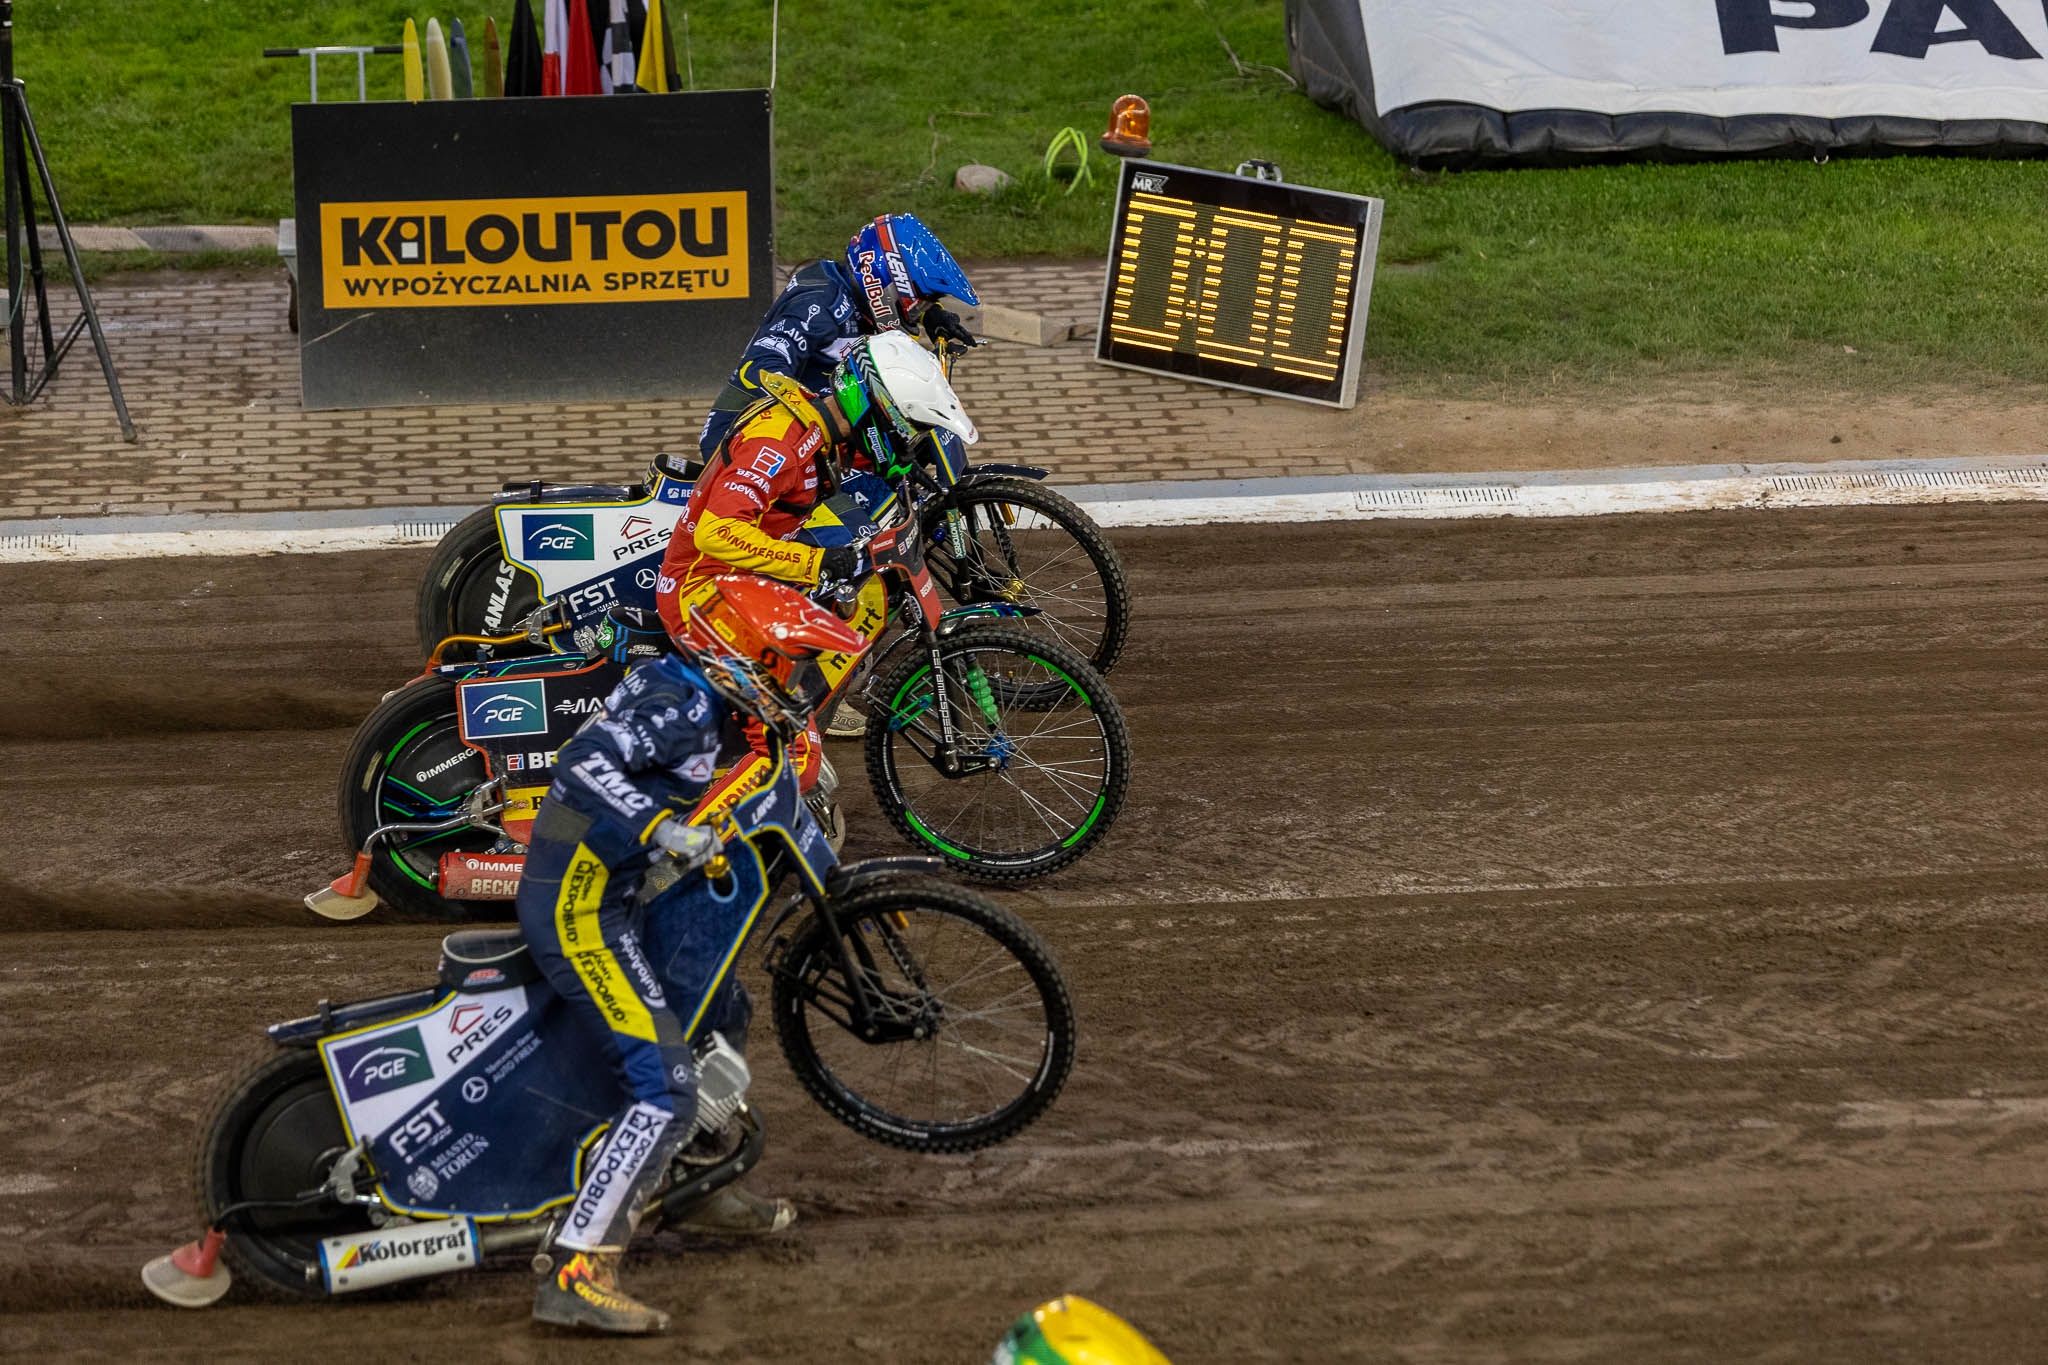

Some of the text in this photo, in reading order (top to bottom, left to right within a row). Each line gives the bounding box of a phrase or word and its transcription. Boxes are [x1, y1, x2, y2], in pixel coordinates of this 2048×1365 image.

[1715, 0, 2048, 60] PA
[344, 268, 729, 297] WYPOŻYCZALNIA SPRZĘTU
[539, 537, 576, 549] PGE
[613, 527, 673, 560] PRES
[727, 534, 801, 563] IMMERGAS
[484, 560, 516, 629] ANLAS
[568, 577, 616, 613] FST
[485, 707, 524, 723] PGE
[562, 873, 583, 943] EXPOBUD
[582, 955, 626, 1023] EXPOBUD
[447, 1005, 513, 1064] PRES
[364, 1057, 406, 1086] PGE
[389, 1099, 446, 1157] FST
[622, 1138, 650, 1180] DOMY
[573, 1128, 638, 1230] EXPOBUD
[359, 1227, 468, 1263] Kolorgraf
